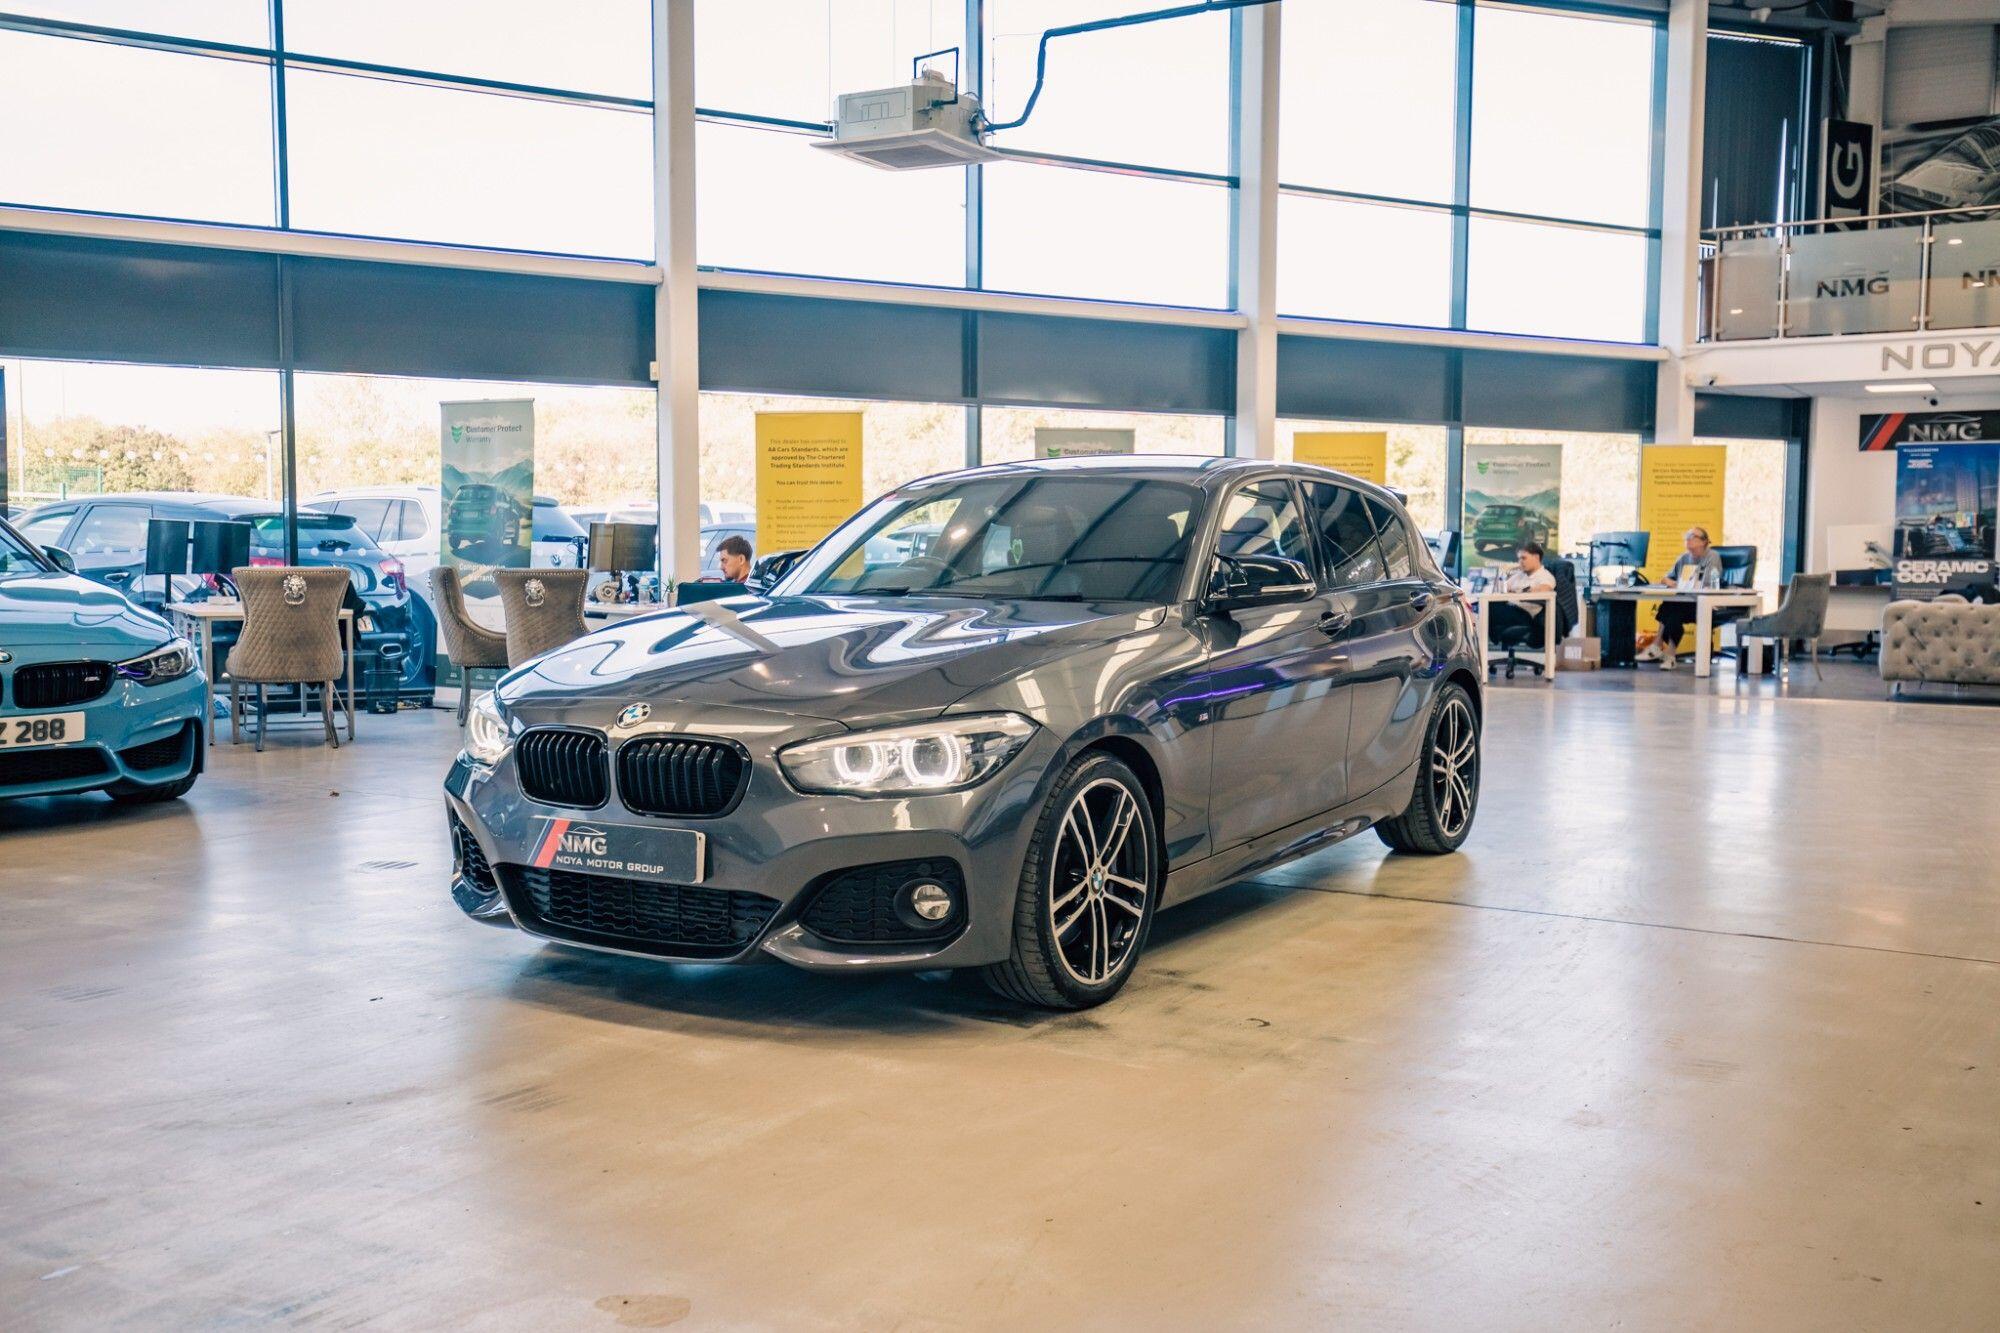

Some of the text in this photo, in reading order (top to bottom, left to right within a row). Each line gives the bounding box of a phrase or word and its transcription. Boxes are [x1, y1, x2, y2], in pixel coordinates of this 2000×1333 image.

[1817, 277, 1890, 298] NMG
[466, 424, 522, 433] Customer Protect
[1908, 422, 1982, 442] NMG
[1897, 560, 1989, 574] CERAMIC
[1897, 572, 1952, 583] COAT
[15, 718, 65, 743] 288
[557, 833, 607, 855] NMG
[556, 856, 664, 874] NOYA MOTOR GROUP
